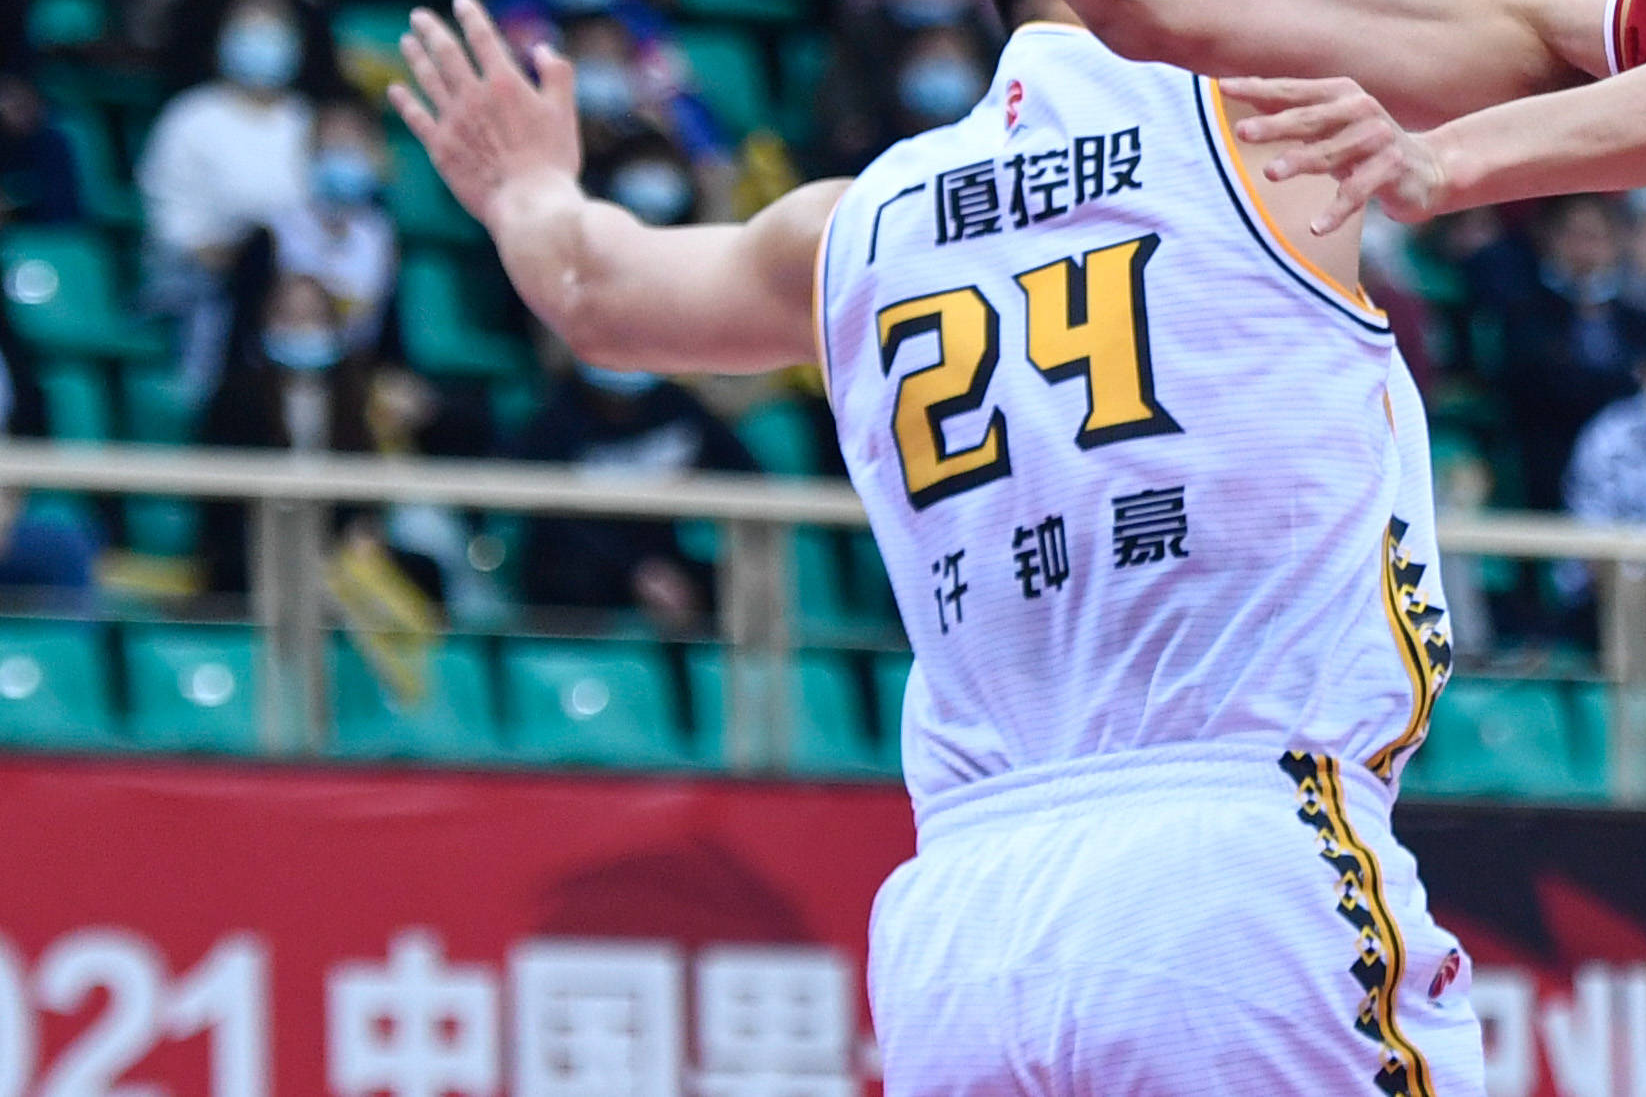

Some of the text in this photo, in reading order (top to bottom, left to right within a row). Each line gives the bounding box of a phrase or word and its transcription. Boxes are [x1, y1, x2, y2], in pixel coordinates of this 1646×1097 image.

[867, 125, 1143, 266] 广厦控股
[876, 233, 1185, 511] 24
[931, 485, 1190, 635] 许钟豪
[0, 927, 272, 1097] 21
[325, 926, 881, 1097] 中国男
